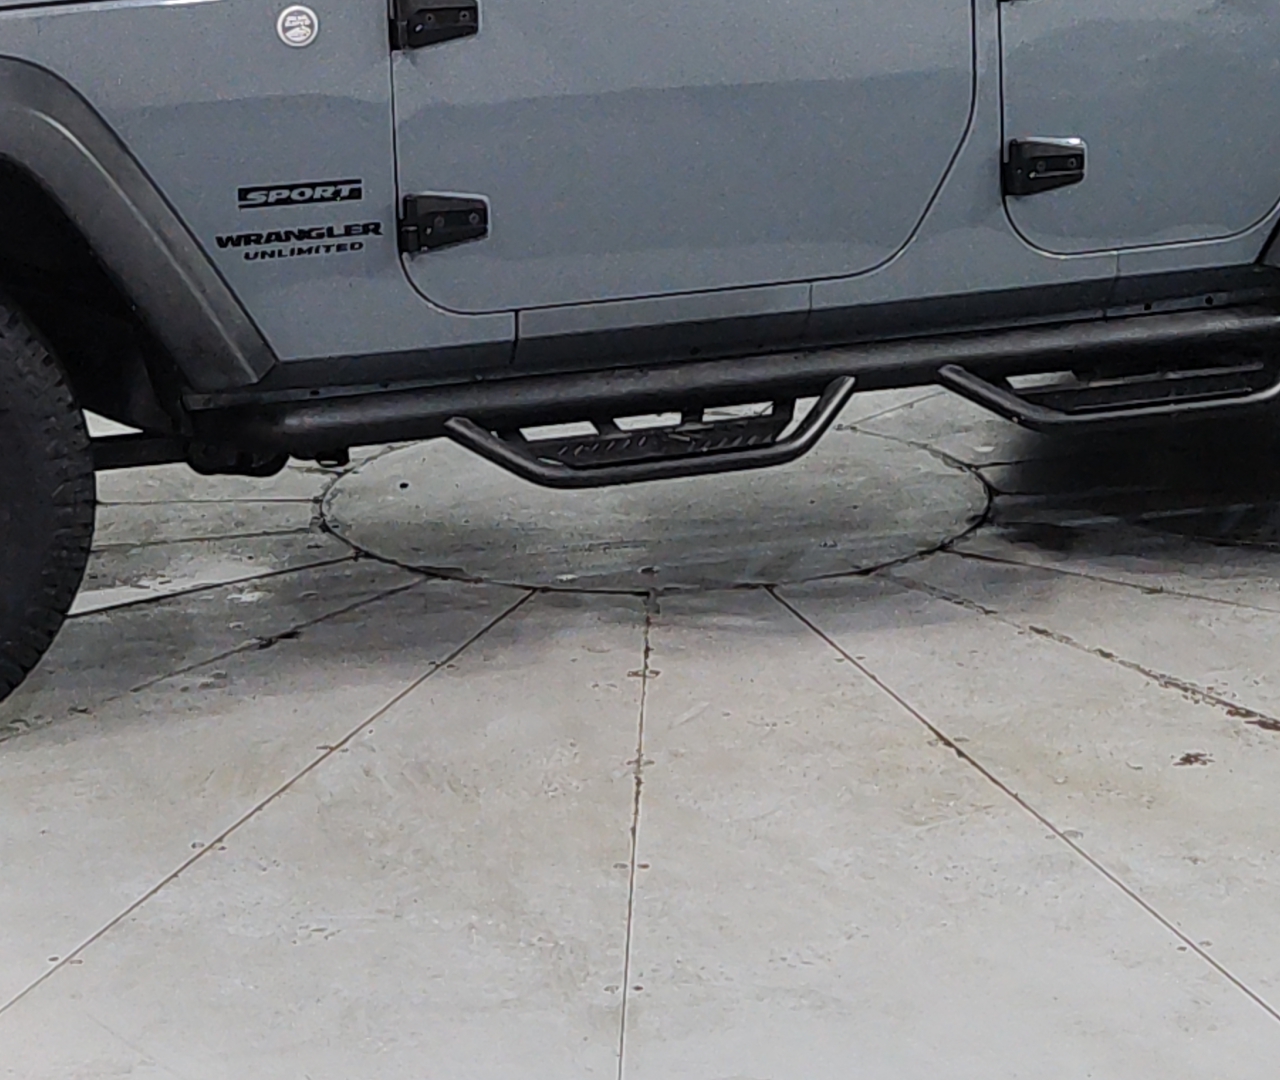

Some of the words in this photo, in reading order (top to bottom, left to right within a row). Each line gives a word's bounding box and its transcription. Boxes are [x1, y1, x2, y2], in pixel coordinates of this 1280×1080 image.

[246, 184, 362, 204] SPORT
[215, 222, 383, 248] WRANGLER
[244, 242, 364, 261] UNLIMITED
